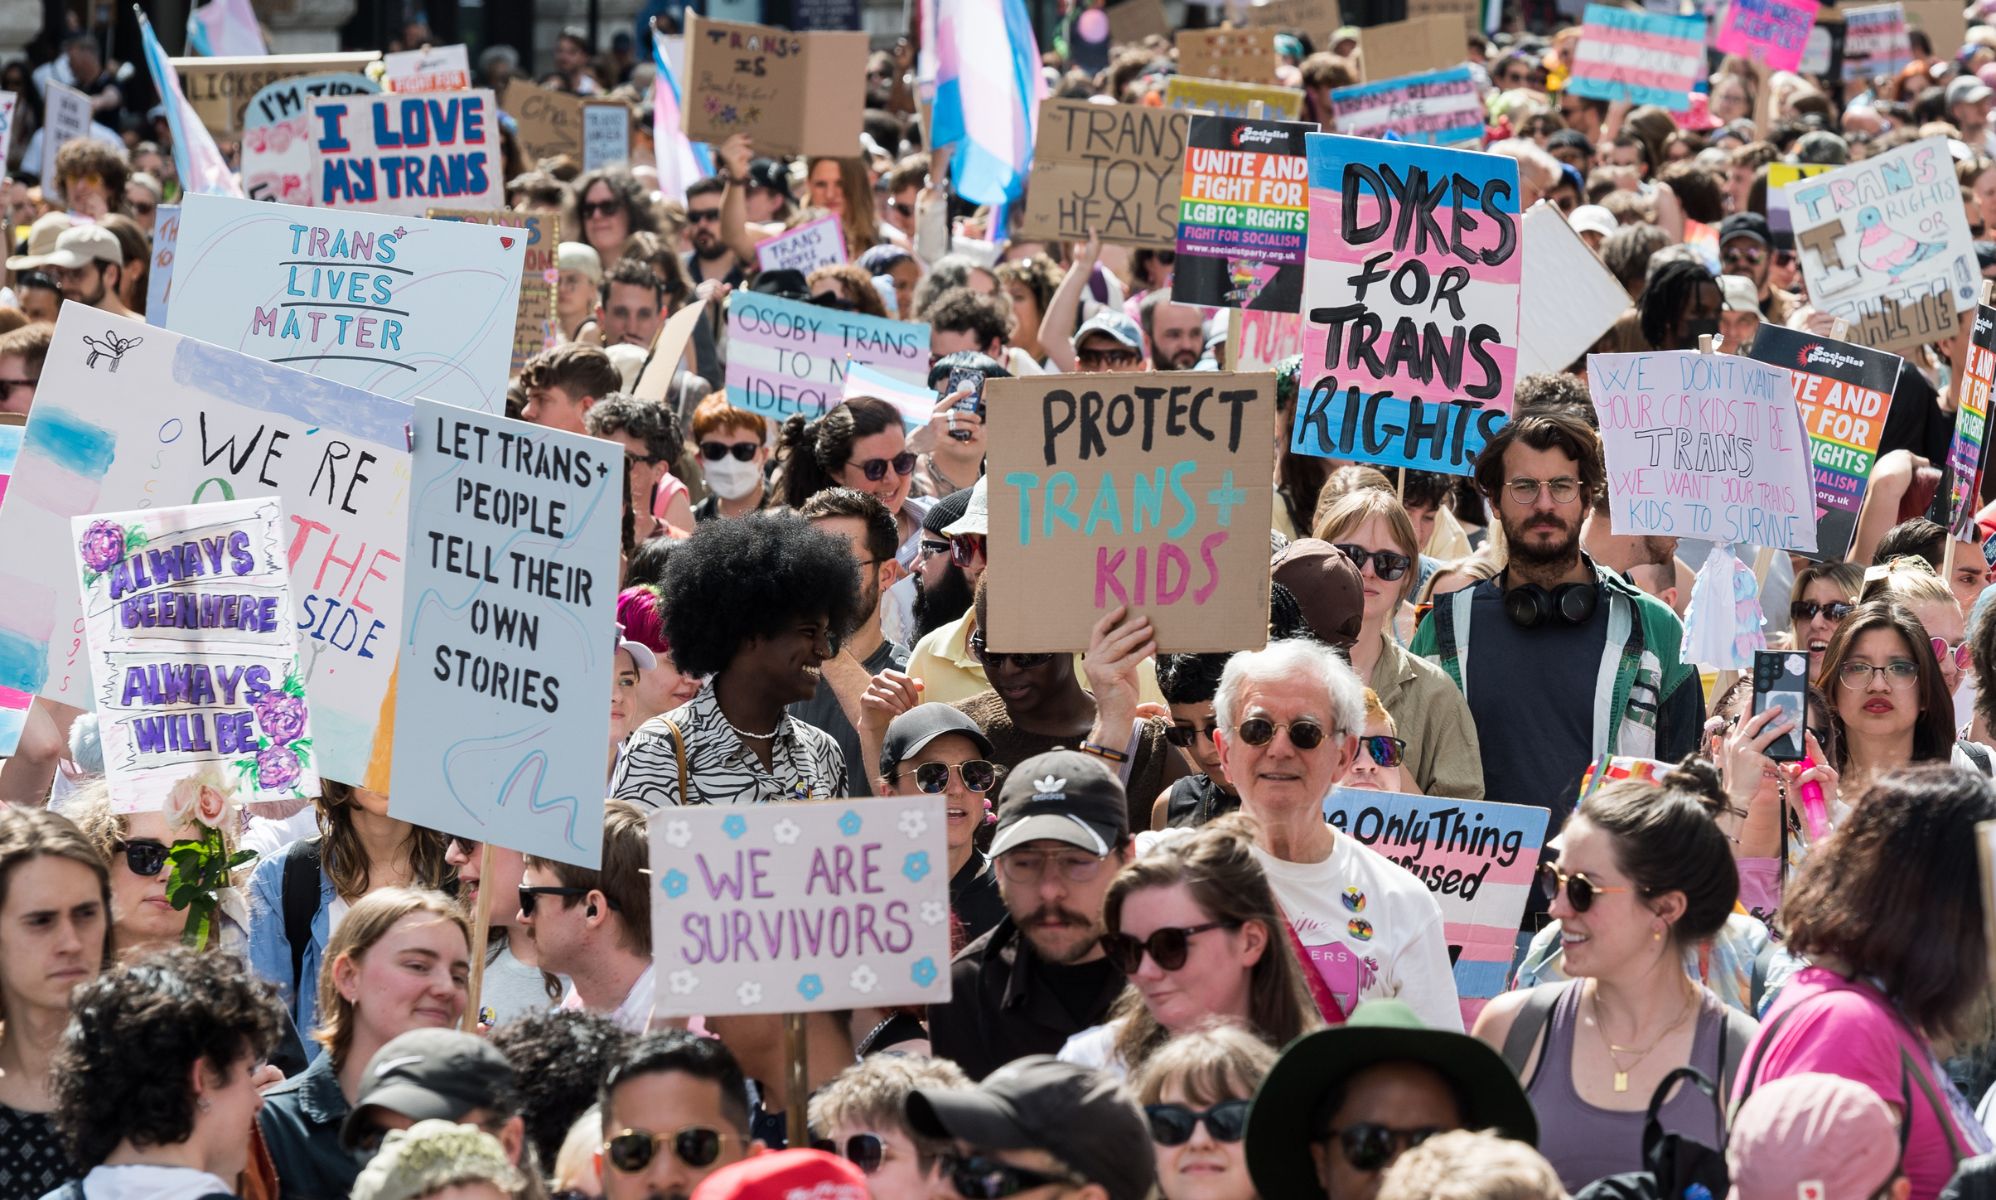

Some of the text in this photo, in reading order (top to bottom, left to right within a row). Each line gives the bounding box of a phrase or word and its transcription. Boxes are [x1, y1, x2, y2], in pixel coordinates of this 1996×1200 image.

[735, 57, 767, 77] IS
[259, 85, 301, 122] I'M
[1337, 80, 1474, 114] TRANS RIGHTS
[1388, 102, 1425, 119] ARE
[315, 105, 350, 153] I
[372, 97, 486, 149] LOVE
[1057, 105, 1189, 162] TRANS
[321, 152, 490, 205] MY TRANS
[1072, 154, 1175, 205] JOY
[1192, 149, 1308, 180] UNITE AND
[1795, 147, 1937, 222] TRANS
[1191, 174, 1302, 206] FIGHT FOR
[1341, 162, 1517, 266] DYKES
[1886, 178, 1956, 222] RIGHTS
[1058, 197, 1178, 241] HEALS
[1184, 202, 1306, 230] LGBTQ+ RIGHTS
[1184, 226, 1301, 248] FIGHT FOR SOCIALISM
[1919, 211, 1949, 234] OR
[769, 228, 822, 258] TRANS
[1186, 244, 1296, 261] www.socialistparty.org.uk
[287, 265, 393, 305] LIVES
[1347, 252, 1470, 320] FOR
[252, 305, 404, 351] MATTER
[738, 304, 918, 359] OSOBY TRANS
[1309, 302, 1501, 400] TRANS
[774, 347, 812, 379] TO
[1592, 357, 1654, 391] WE
[1680, 356, 1735, 391] DON'T
[1741, 365, 1781, 399] WANT
[1814, 346, 1864, 367] Socialist
[1298, 375, 1507, 466] RIGHTS
[1597, 394, 1652, 429] YOUR
[1662, 394, 1692, 427] CIS
[1700, 398, 1736, 435] KIDS
[1744, 402, 1760, 442] TO
[1769, 405, 1792, 451] BE
[1824, 382, 1882, 418] AND
[436, 416, 489, 463] LET
[1043, 385, 1258, 467] PROTECT
[1817, 408, 1870, 446] FOR
[200, 411, 377, 514] WE'RE
[1635, 427, 1754, 478] TRANS
[456, 477, 566, 539] PEOPLE
[1610, 468, 1656, 496] WE
[1664, 470, 1714, 500] WANT
[1721, 477, 1753, 503] YOUR
[1758, 482, 1795, 513] TRANS
[1629, 499, 1804, 549] KIDS TO SURVIVE
[110, 530, 254, 600] ALWAYS
[288, 514, 400, 614] THE
[428, 531, 592, 607] TELL THEIR
[1094, 531, 1229, 609] KIDS
[121, 592, 279, 633] BEEN HERE
[471, 599, 538, 651] OWN
[121, 663, 272, 706] ALWAYS
[433, 645, 560, 713] STORIES
[133, 710, 259, 754] WILL BE
[1354, 806, 1430, 860] Only
[1430, 807, 1523, 867] Thing
[695, 843, 884, 900] WE ARE
[681, 900, 913, 964] SURVIVORS
